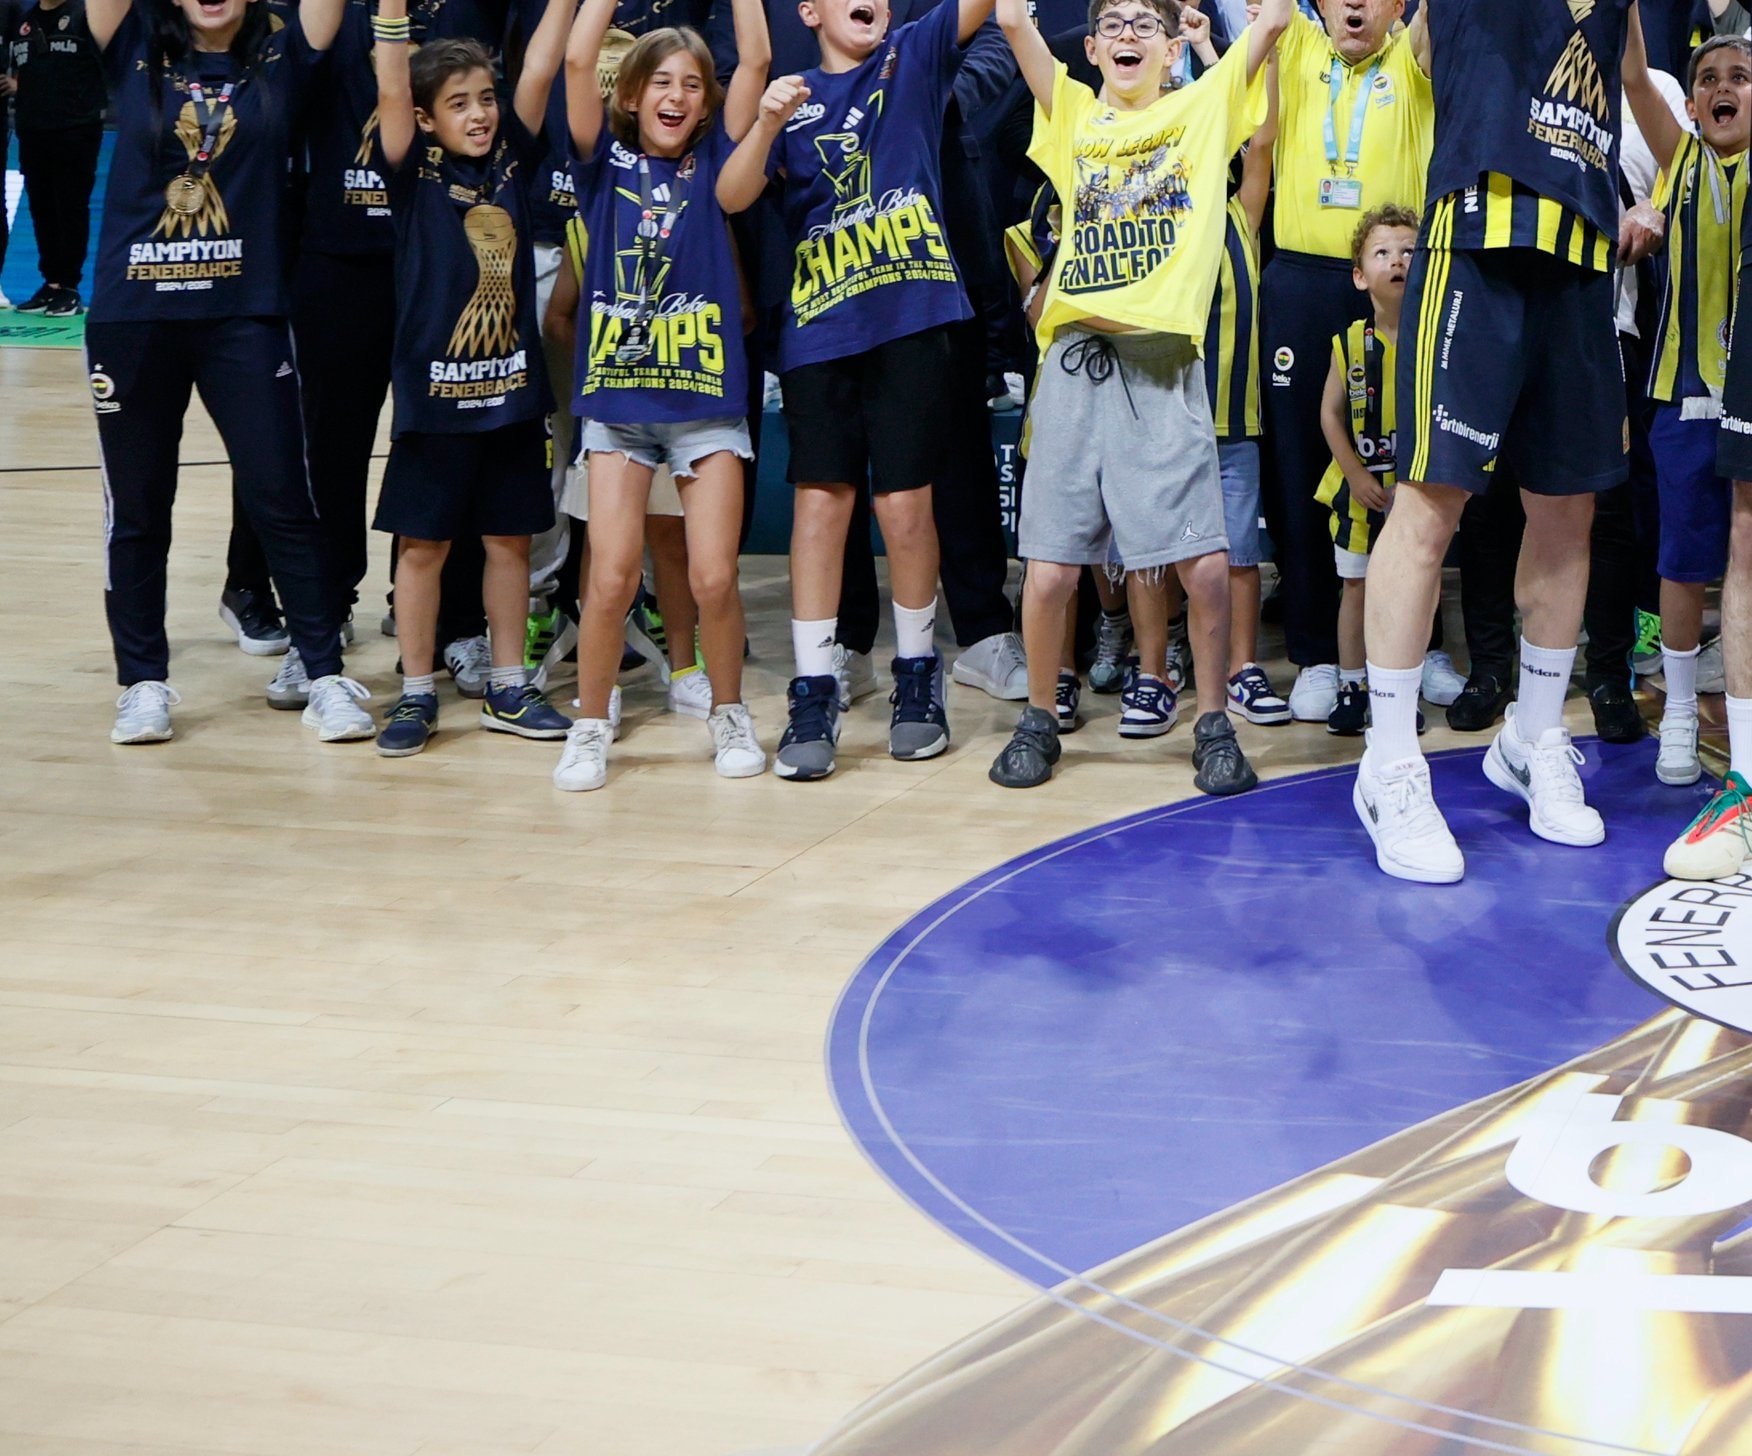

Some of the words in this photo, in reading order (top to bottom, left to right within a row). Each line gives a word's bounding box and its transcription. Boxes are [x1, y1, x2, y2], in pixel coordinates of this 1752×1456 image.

[129, 238, 243, 265] ŞAMPİYON
[791, 195, 951, 309] CHAMPS
[126, 260, 242, 281] FENERBAHÇE
[870, 263, 895, 276] TEAM
[896, 261, 906, 271] IN
[909, 260, 924, 270] THE
[926, 260, 955, 271] WORLD
[155, 280, 213, 292] 2024/2025
[847, 272, 902, 299] CHAMPIONS
[905, 269, 957, 283] 2024/2025
[429, 349, 527, 383] ŞAMPİYON
[633, 368, 660, 377] TEAM
[662, 369, 672, 377] IN
[675, 370, 693, 378] THE
[604, 377, 666, 389] CHAMPIONS
[669, 378, 724, 398] 2024/2025
